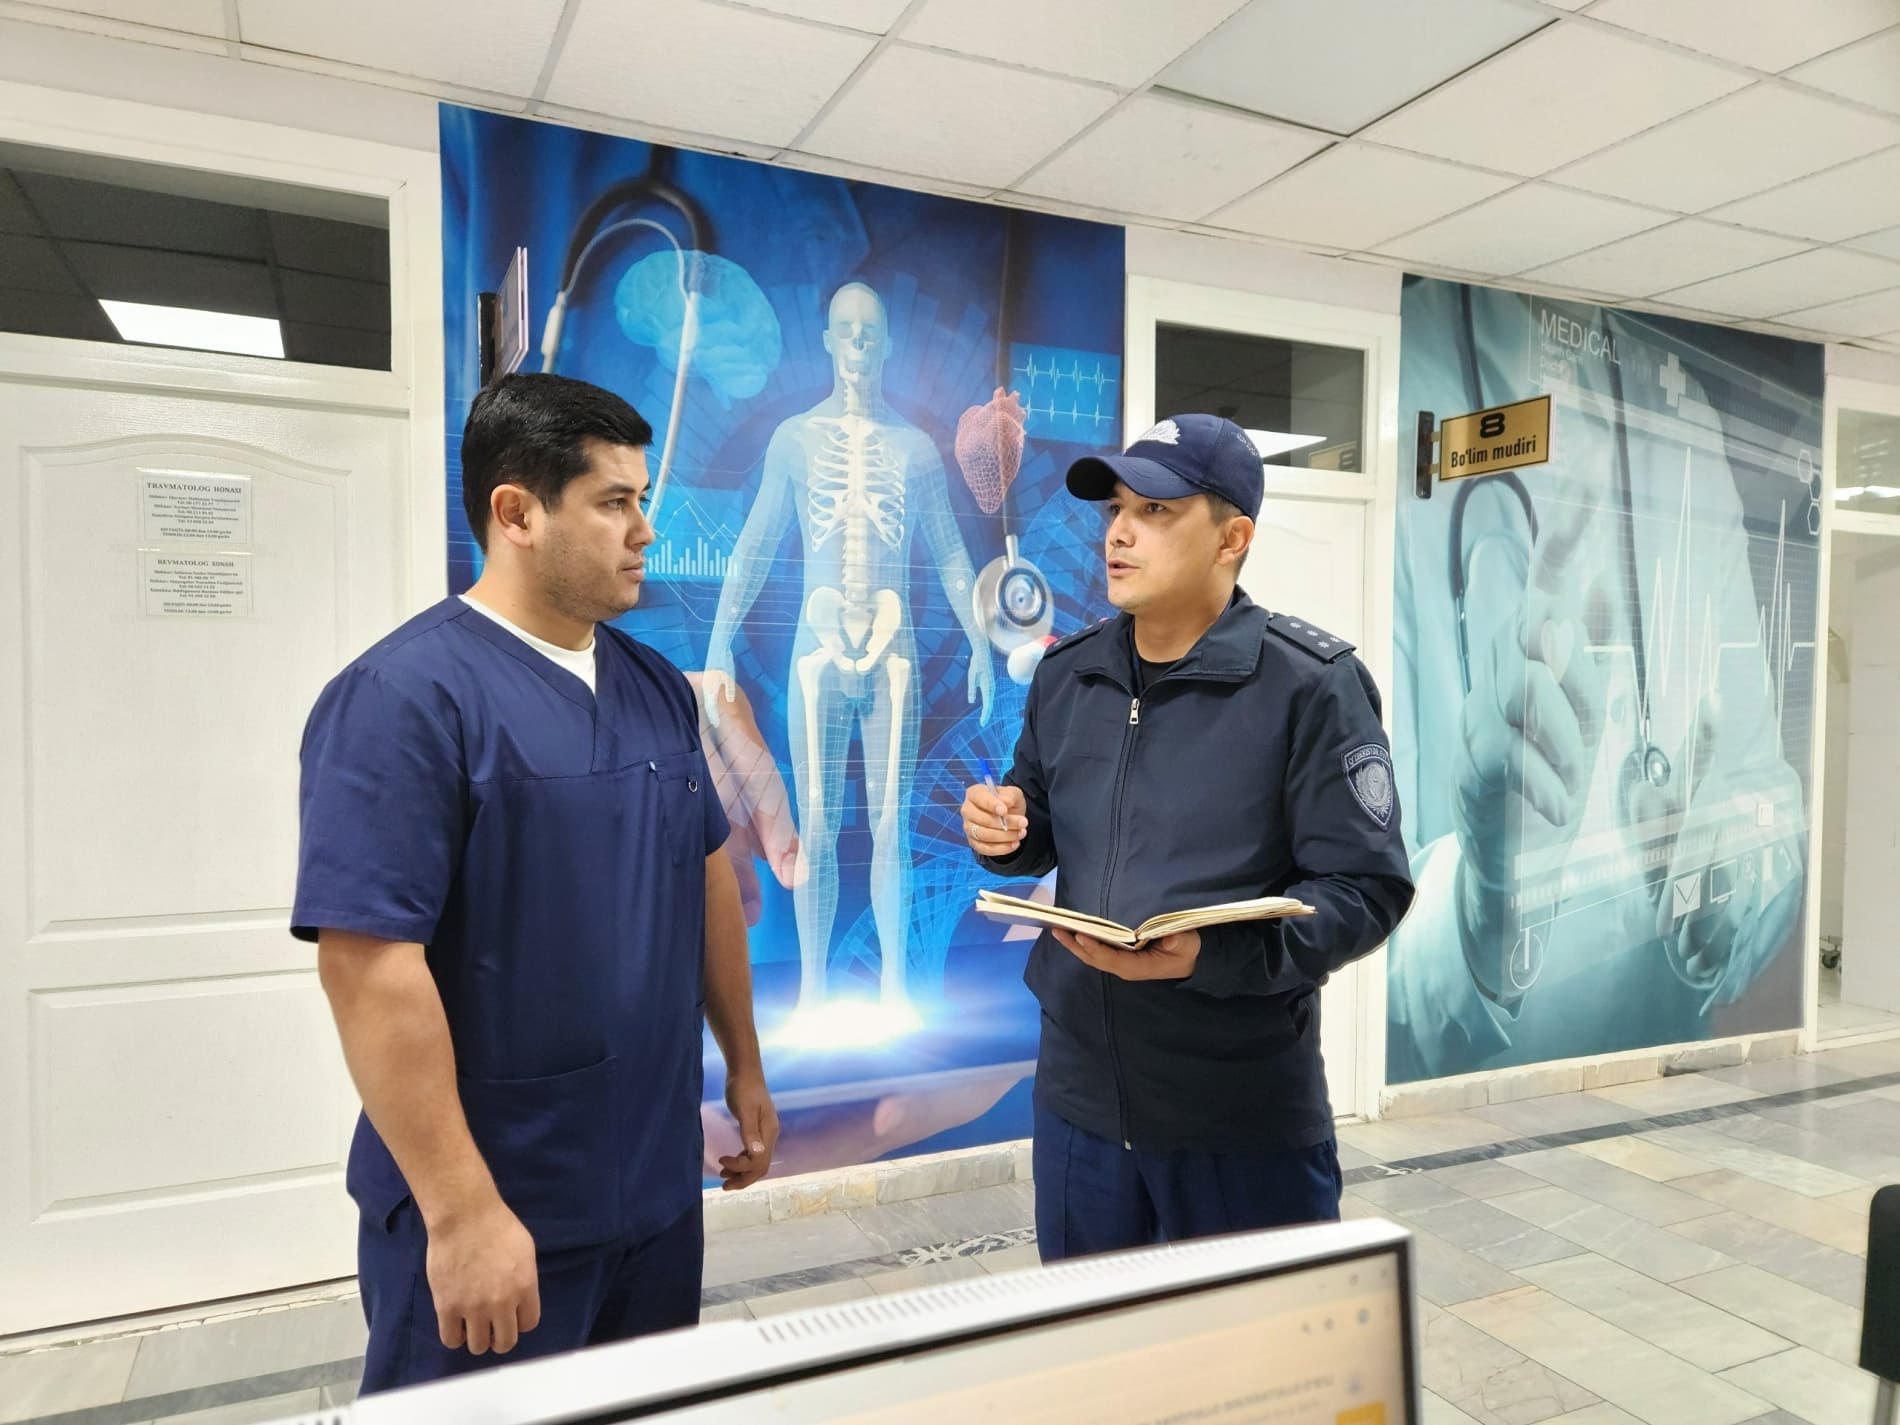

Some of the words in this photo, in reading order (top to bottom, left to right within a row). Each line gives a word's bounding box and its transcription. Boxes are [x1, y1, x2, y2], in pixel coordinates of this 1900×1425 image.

[1541, 309, 1621, 364] MEDICAL
[1479, 412, 1506, 439] 8
[1451, 449, 1488, 468] Bo'lim
[1492, 434, 1537, 461] mudiri
[146, 482, 211, 492] TRAVMATOLOG
[157, 559, 209, 567] REVMATOLOG
